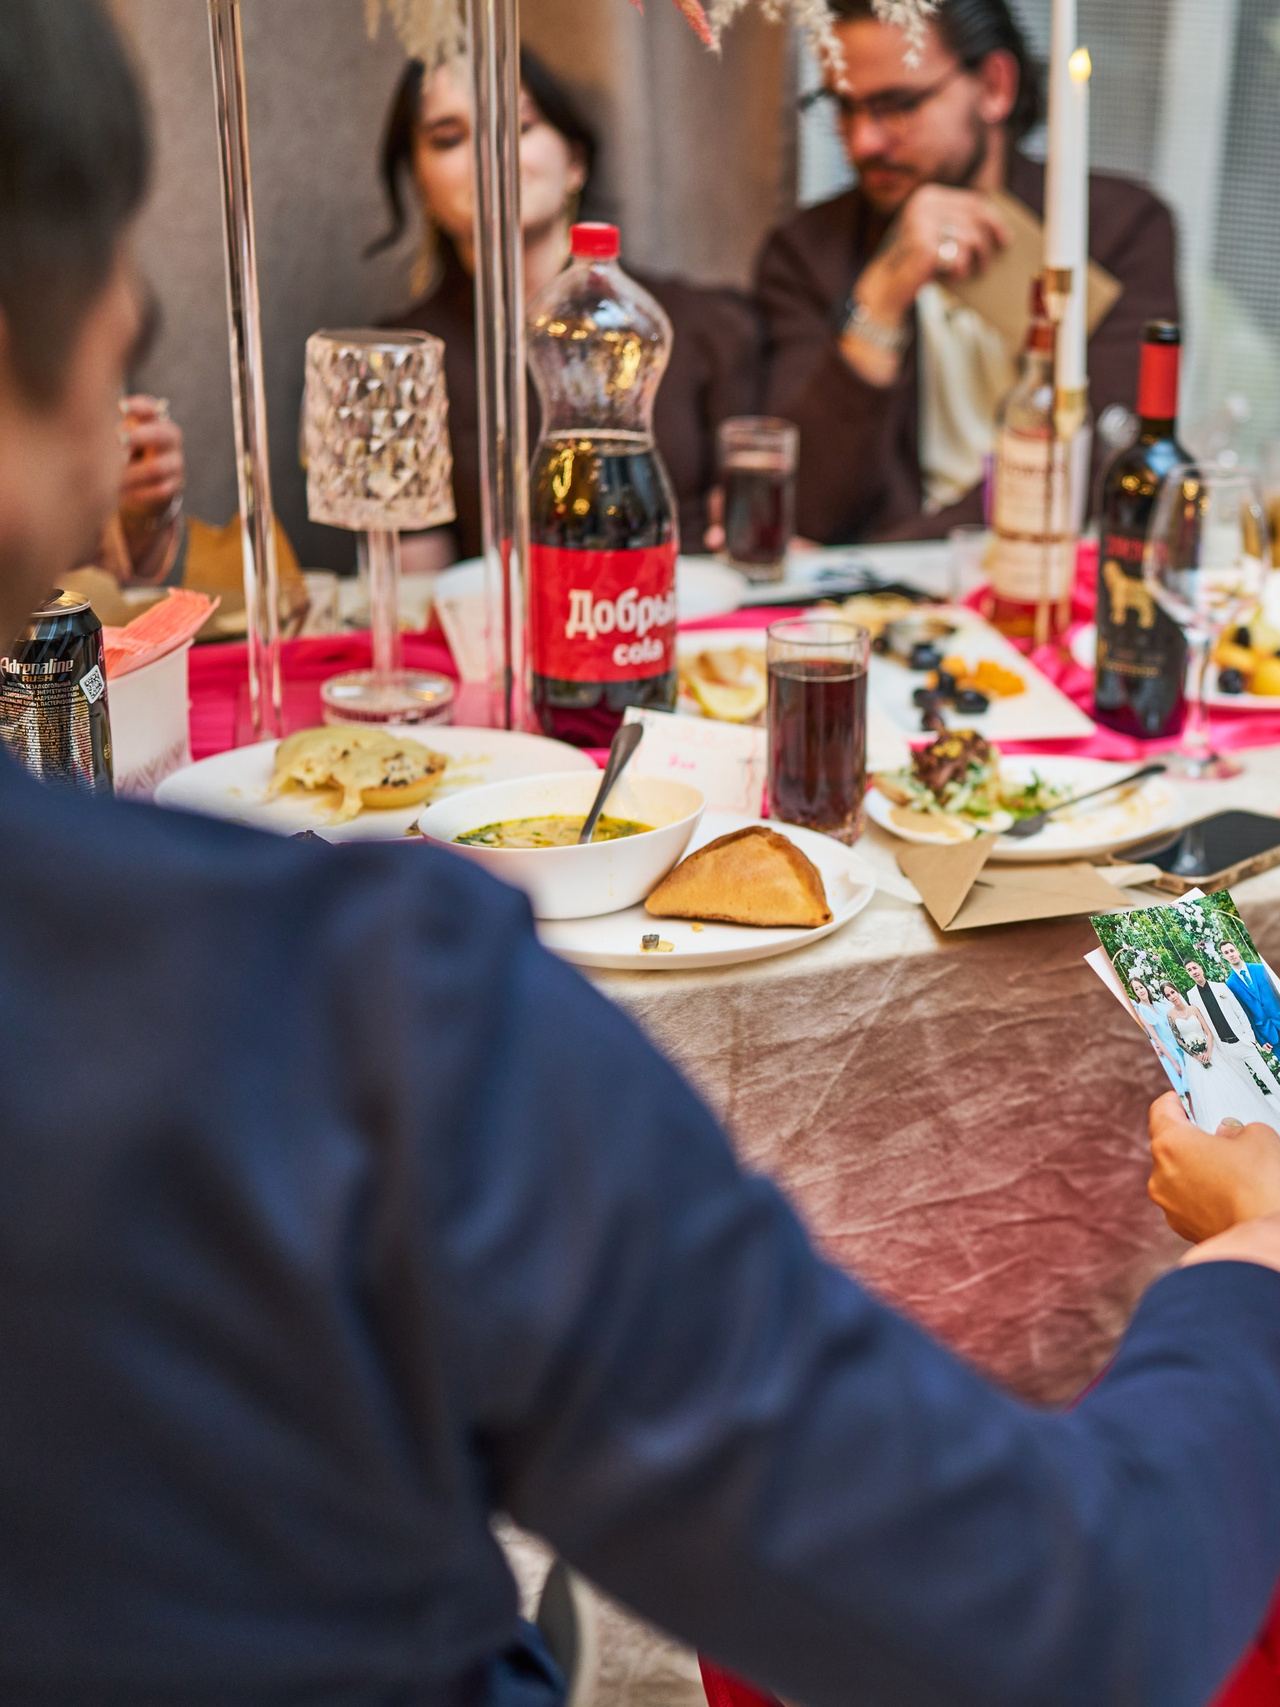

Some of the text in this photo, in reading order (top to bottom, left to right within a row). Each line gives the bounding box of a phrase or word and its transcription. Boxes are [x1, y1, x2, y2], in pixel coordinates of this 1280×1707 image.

[612, 638, 664, 666] cola
[0, 657, 74, 677] Adrenaline
[22, 674, 53, 682] RUSH
